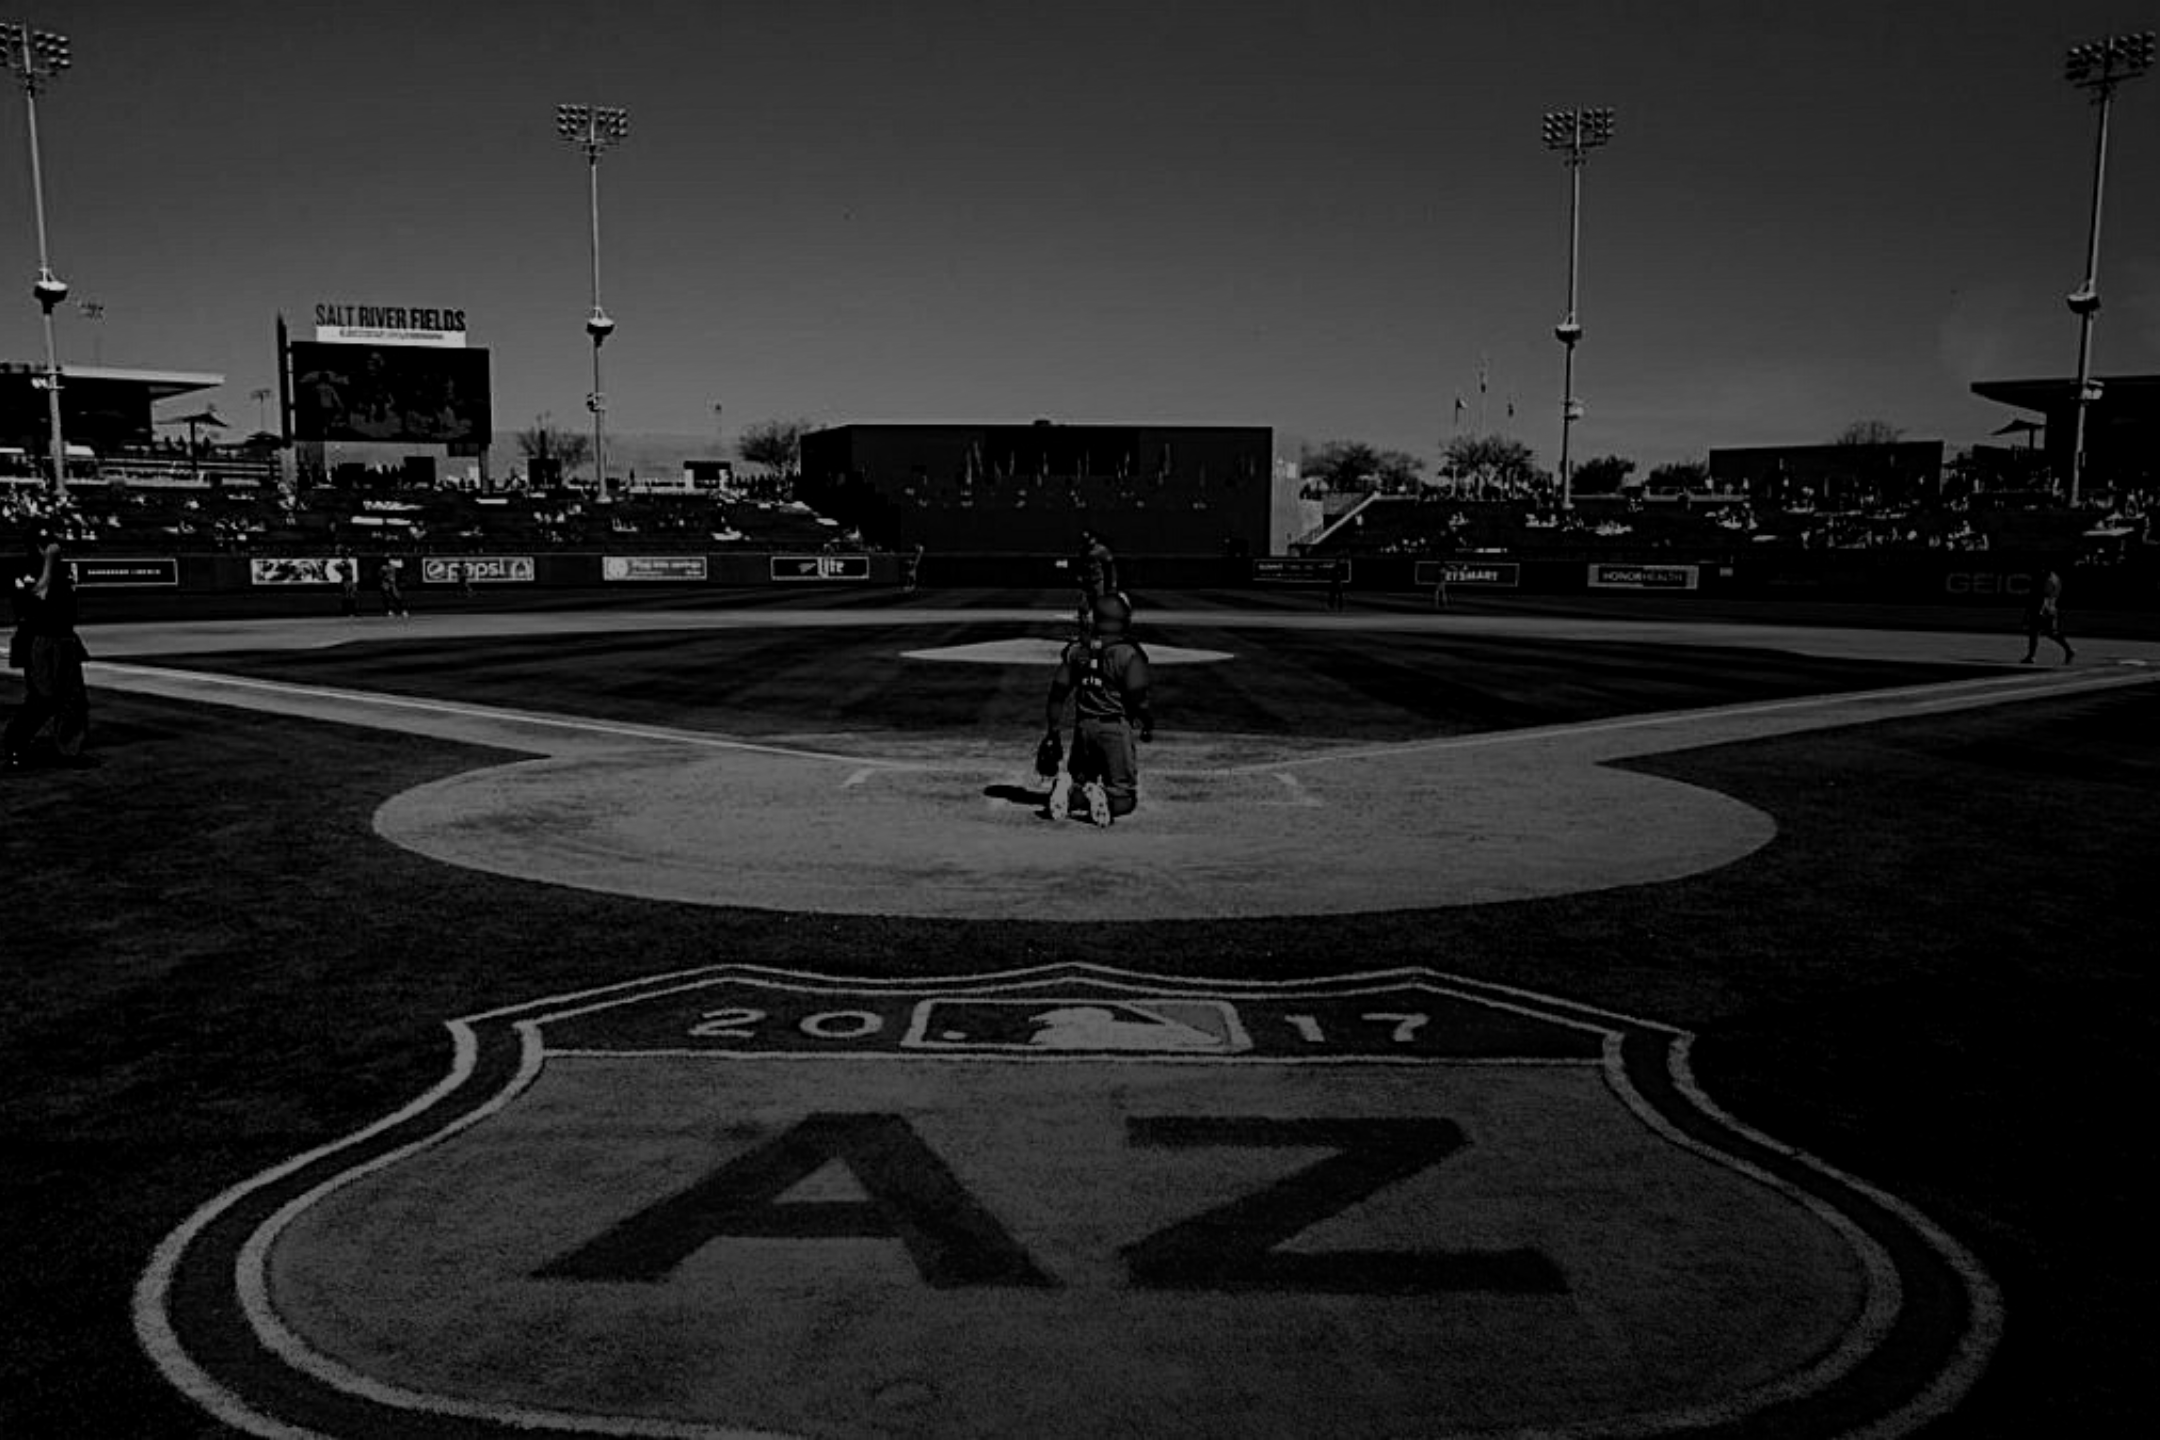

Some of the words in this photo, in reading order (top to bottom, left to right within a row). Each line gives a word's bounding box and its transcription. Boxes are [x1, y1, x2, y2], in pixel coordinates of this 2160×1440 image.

[316, 304, 354, 327] SALT
[358, 306, 407, 329] RIVER
[410, 308, 466, 331] FIELDS
[1944, 571, 2033, 596] GEIC
[687, 1006, 885, 1038] 20
[1284, 1010, 1431, 1043] 17
[529, 1110, 1572, 1294] AZ
